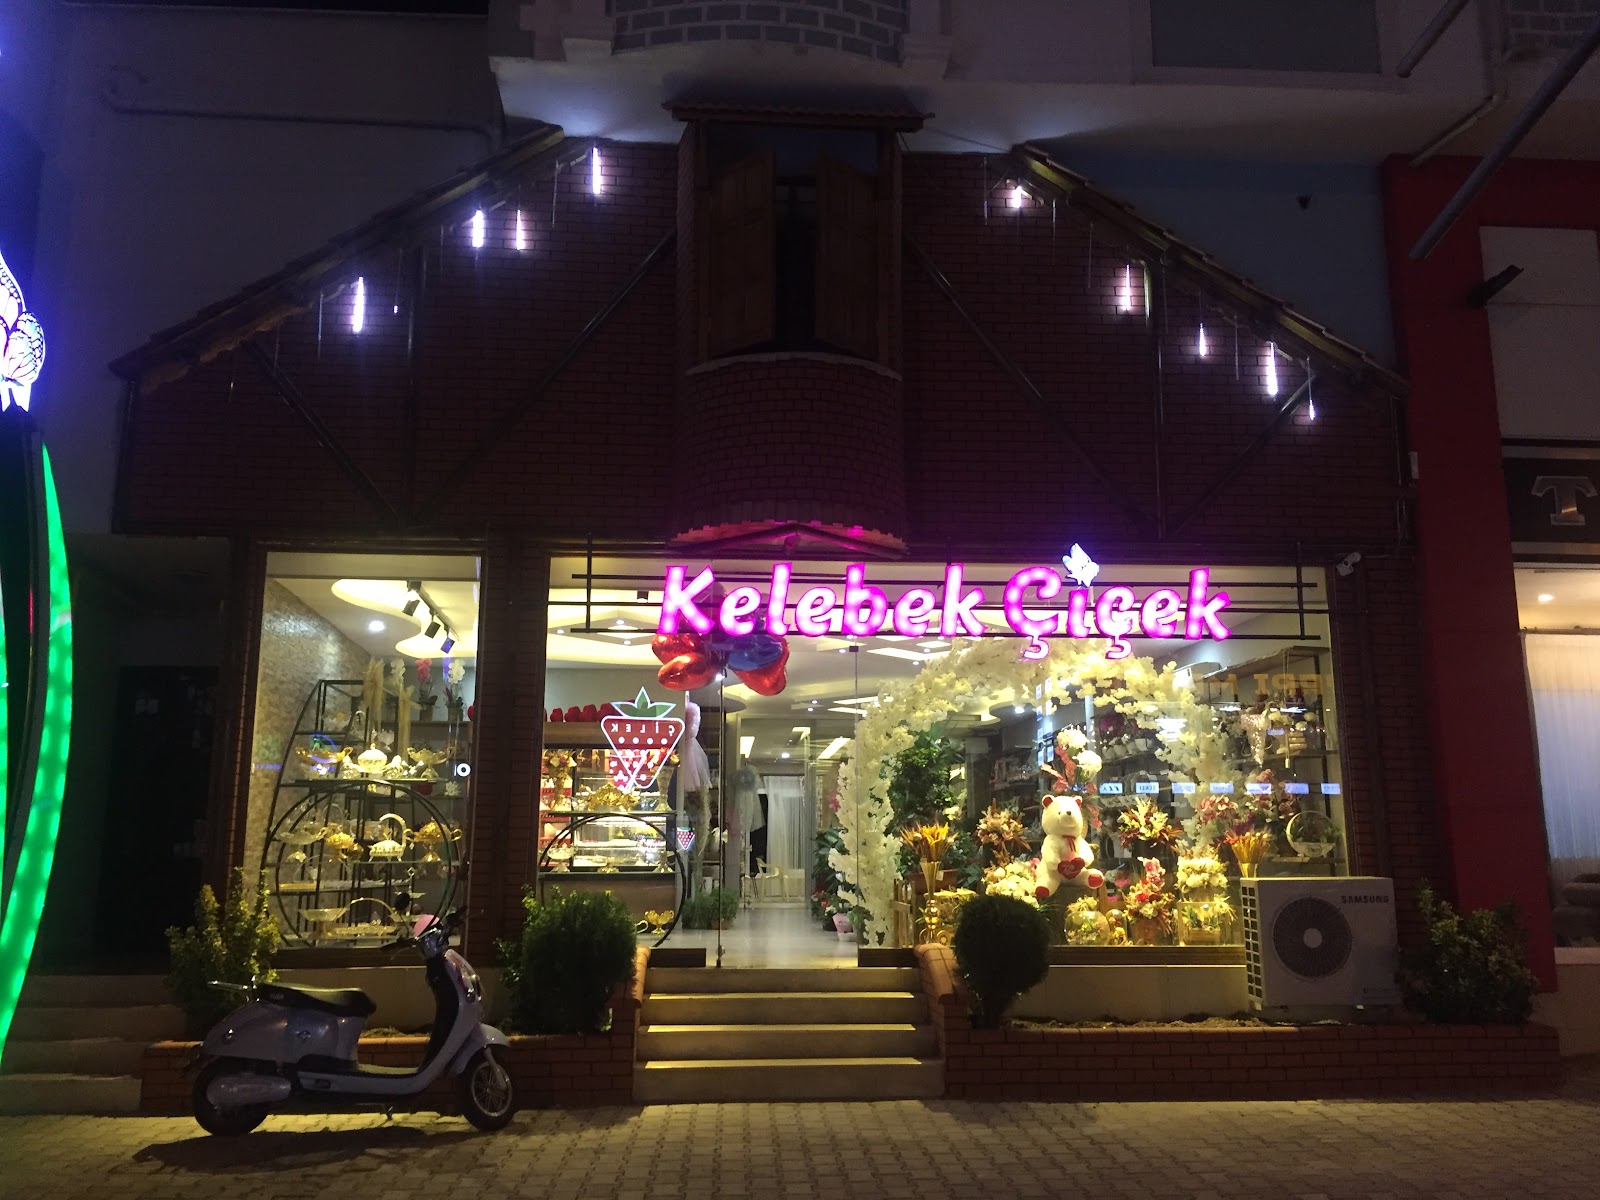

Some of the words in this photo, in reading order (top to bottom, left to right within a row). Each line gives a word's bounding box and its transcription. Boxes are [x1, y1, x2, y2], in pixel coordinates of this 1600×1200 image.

[1531, 475, 1598, 526] T
[657, 562, 987, 638] Kelebek
[1003, 565, 1232, 661] Çiçek
[1340, 895, 1390, 904] SAMSUNG
